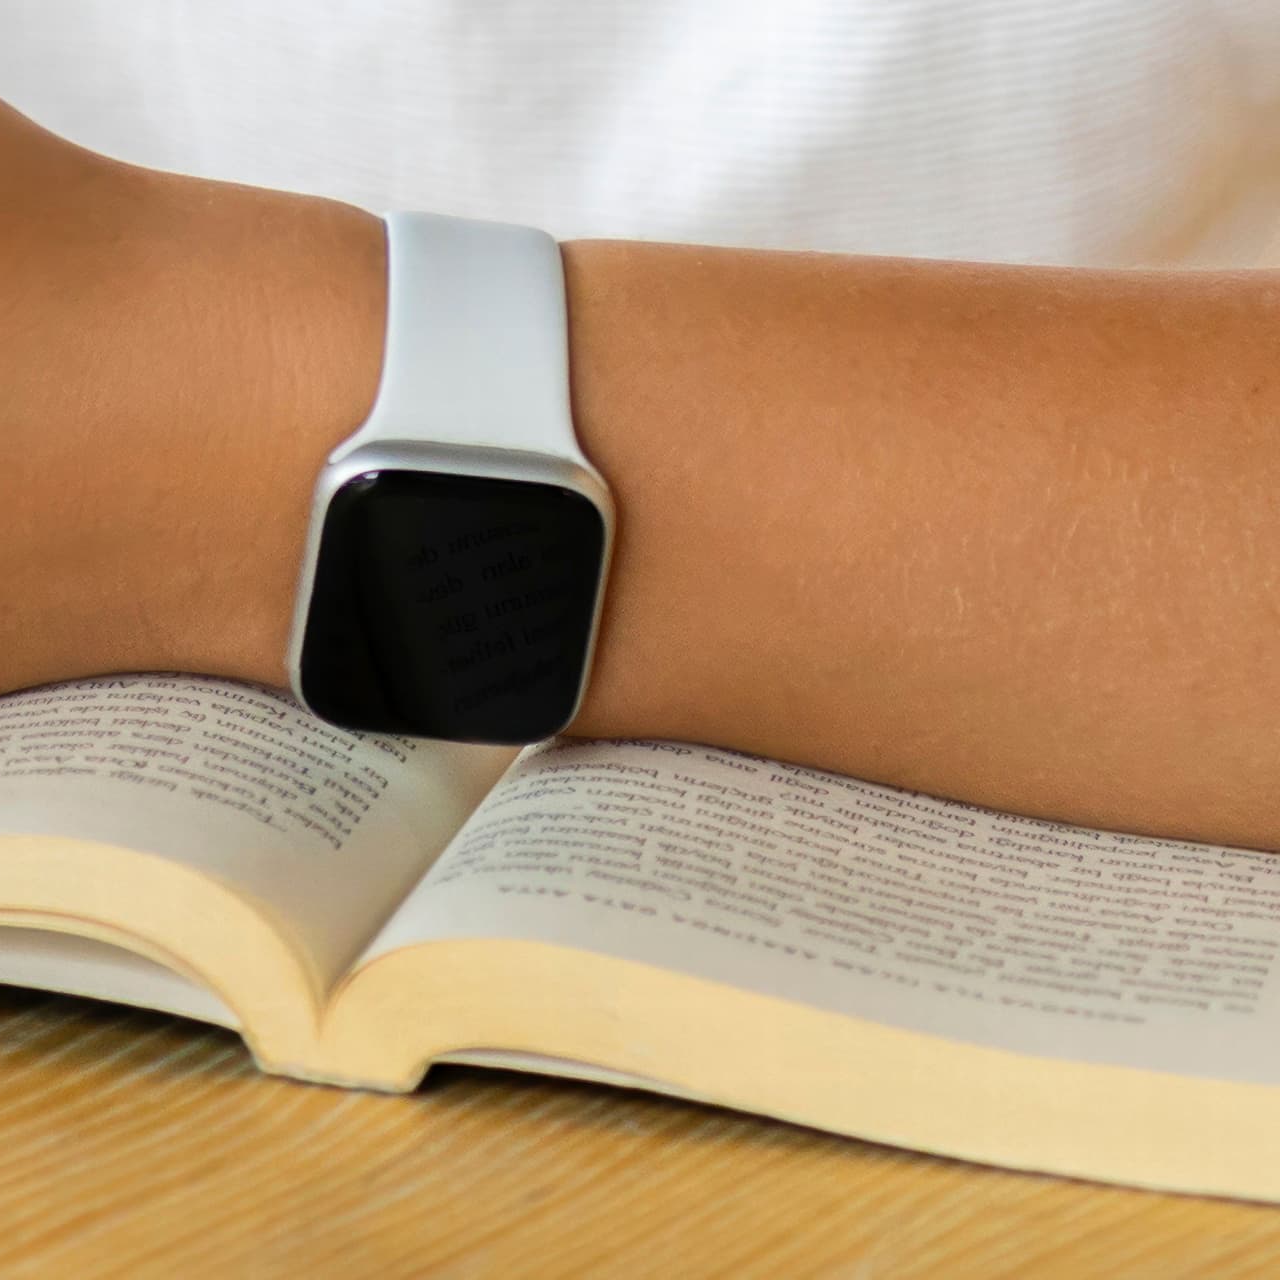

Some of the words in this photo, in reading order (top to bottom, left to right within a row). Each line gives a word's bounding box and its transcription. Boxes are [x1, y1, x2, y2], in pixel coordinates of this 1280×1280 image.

[68, 704, 171, 715] işlerinde
[200, 731, 312, 778] Türkistan
[703, 754, 758, 772] ama
[537, 762, 660, 778] bölgedeki
[671, 773, 774, 805] güçlerin
[768, 773, 831, 796] değil
[586, 788, 687, 810] modern
[783, 804, 860, 834] büyük
[855, 799, 977, 838] doğrudan
